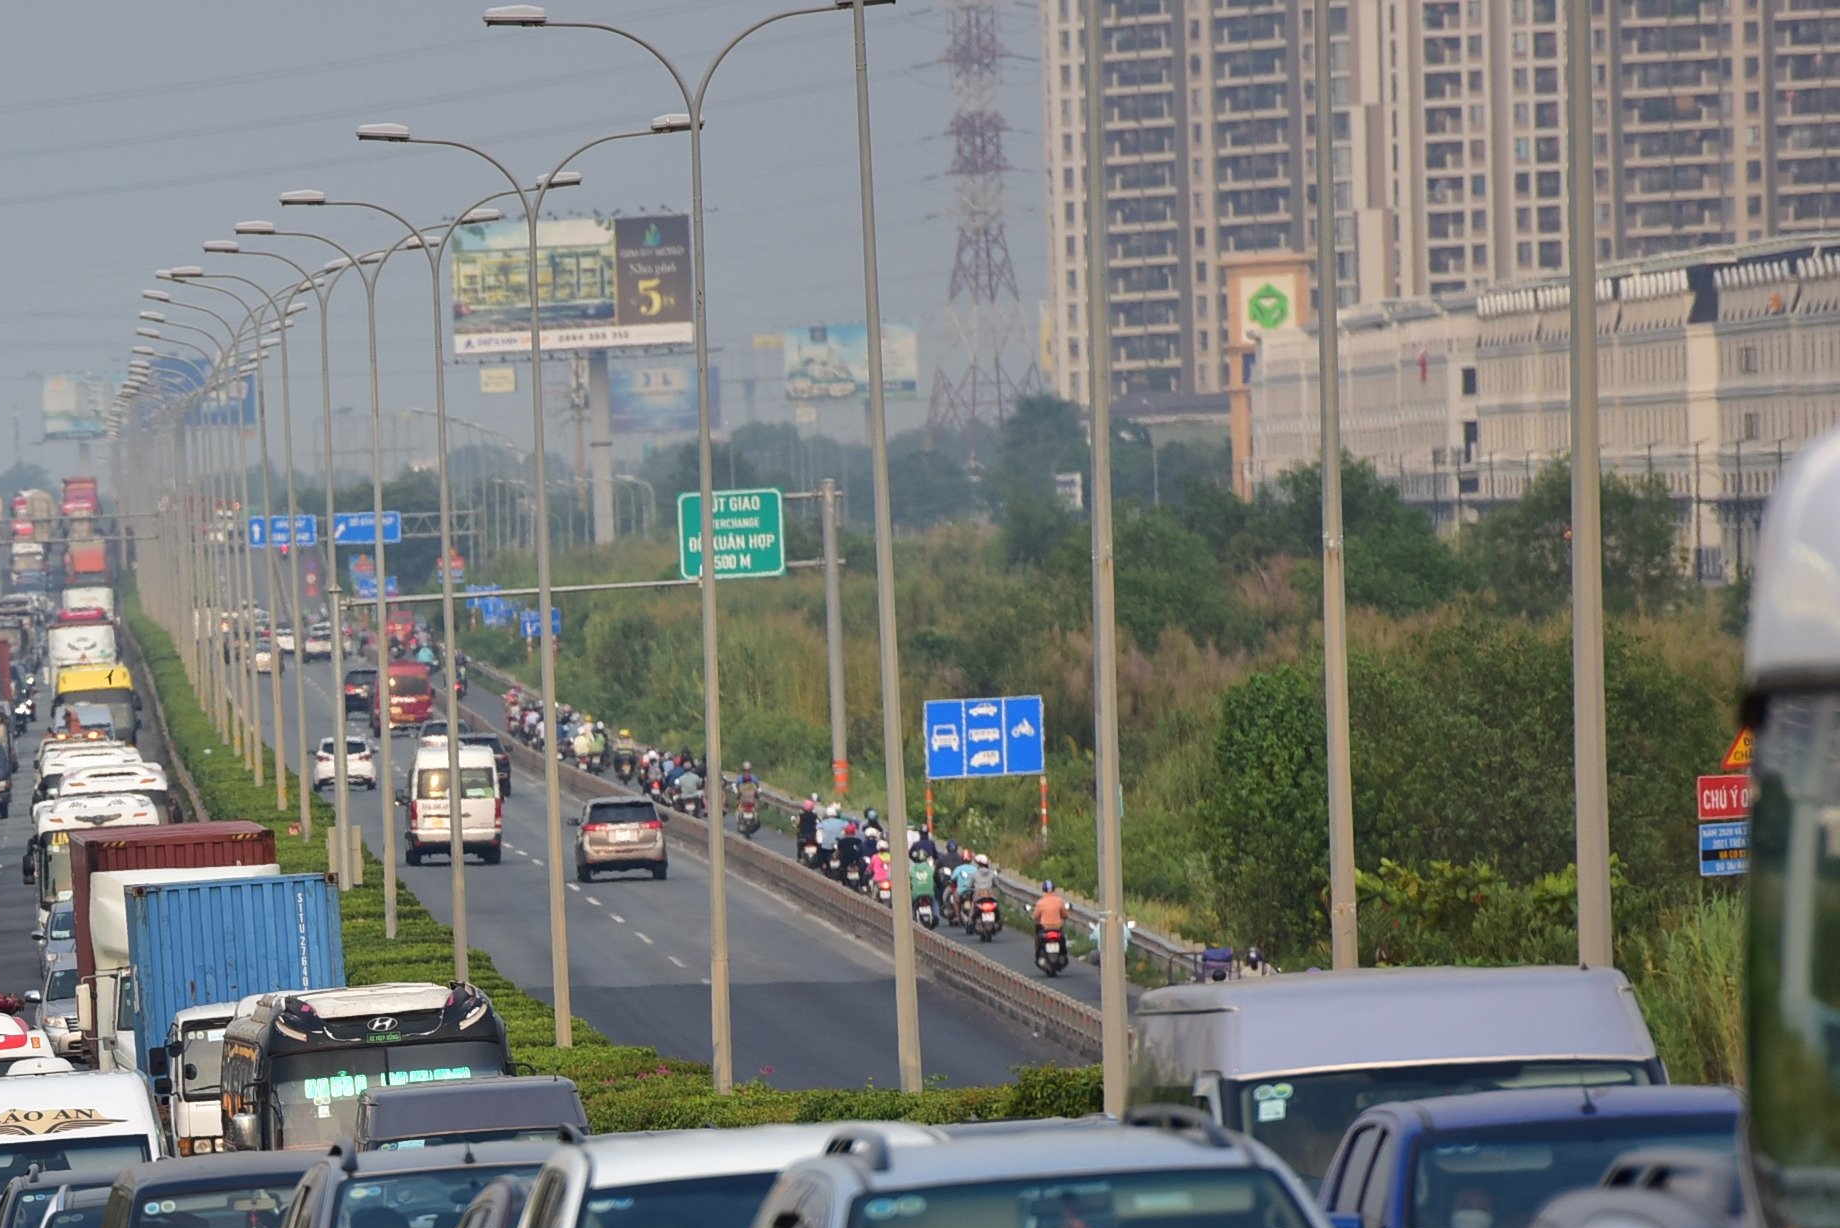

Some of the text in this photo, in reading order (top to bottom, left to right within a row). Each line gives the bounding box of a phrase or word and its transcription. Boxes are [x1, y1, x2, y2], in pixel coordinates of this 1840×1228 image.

[638, 277, 661, 316] 5
[729, 495, 760, 511] GIAO
[740, 553, 751, 569] M
[1703, 785, 1727, 809] CHÚ
[1730, 784, 1738, 808] Ý
[53, 1108, 96, 1120] AN
